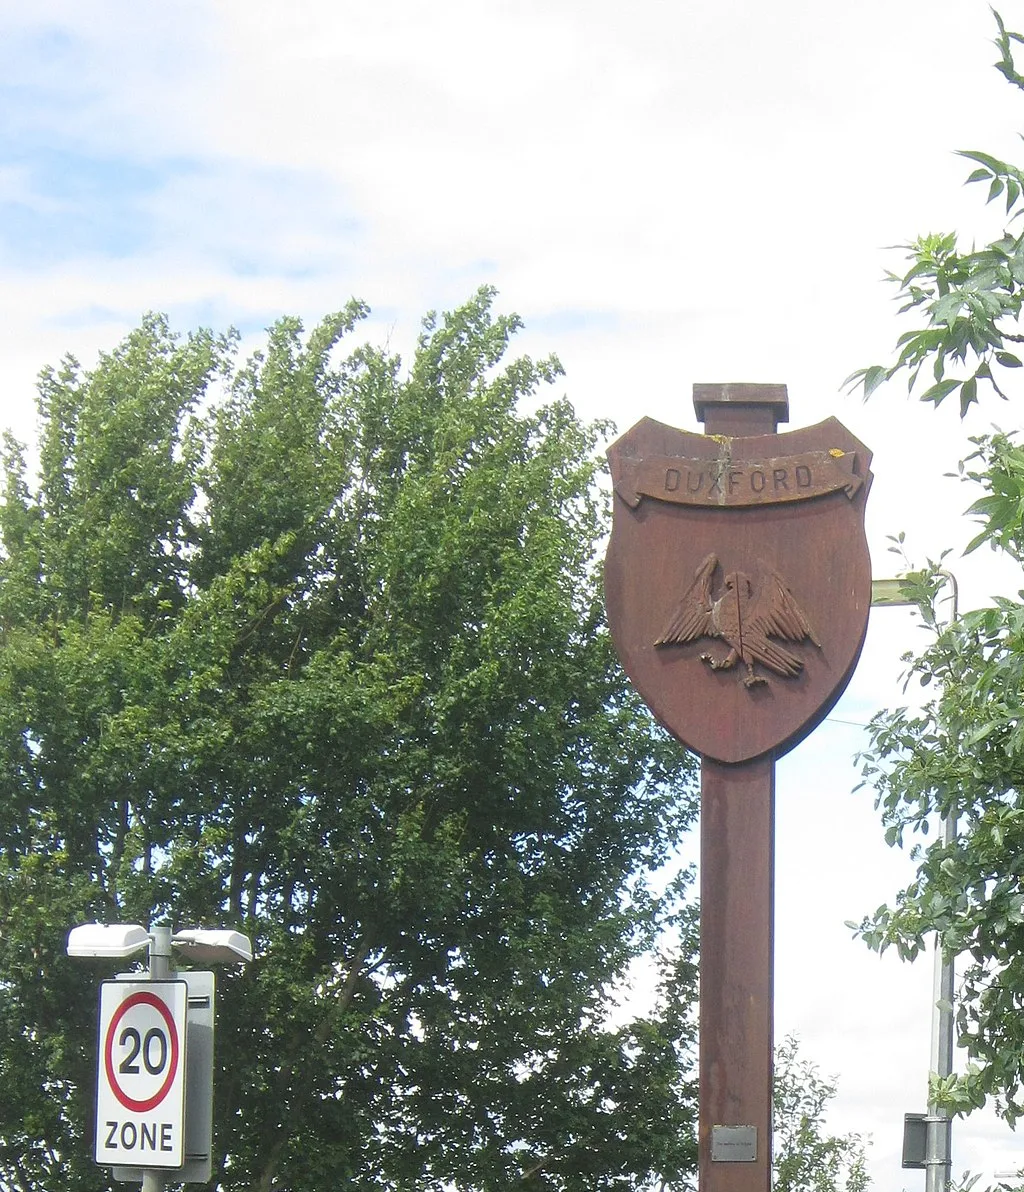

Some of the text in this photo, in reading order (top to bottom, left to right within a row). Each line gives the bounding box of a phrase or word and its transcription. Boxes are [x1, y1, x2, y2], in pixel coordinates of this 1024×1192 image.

[663, 465, 814, 494] DUXFORD
[118, 1027, 168, 1076] 20
[104, 1121, 173, 1152] ZONE
